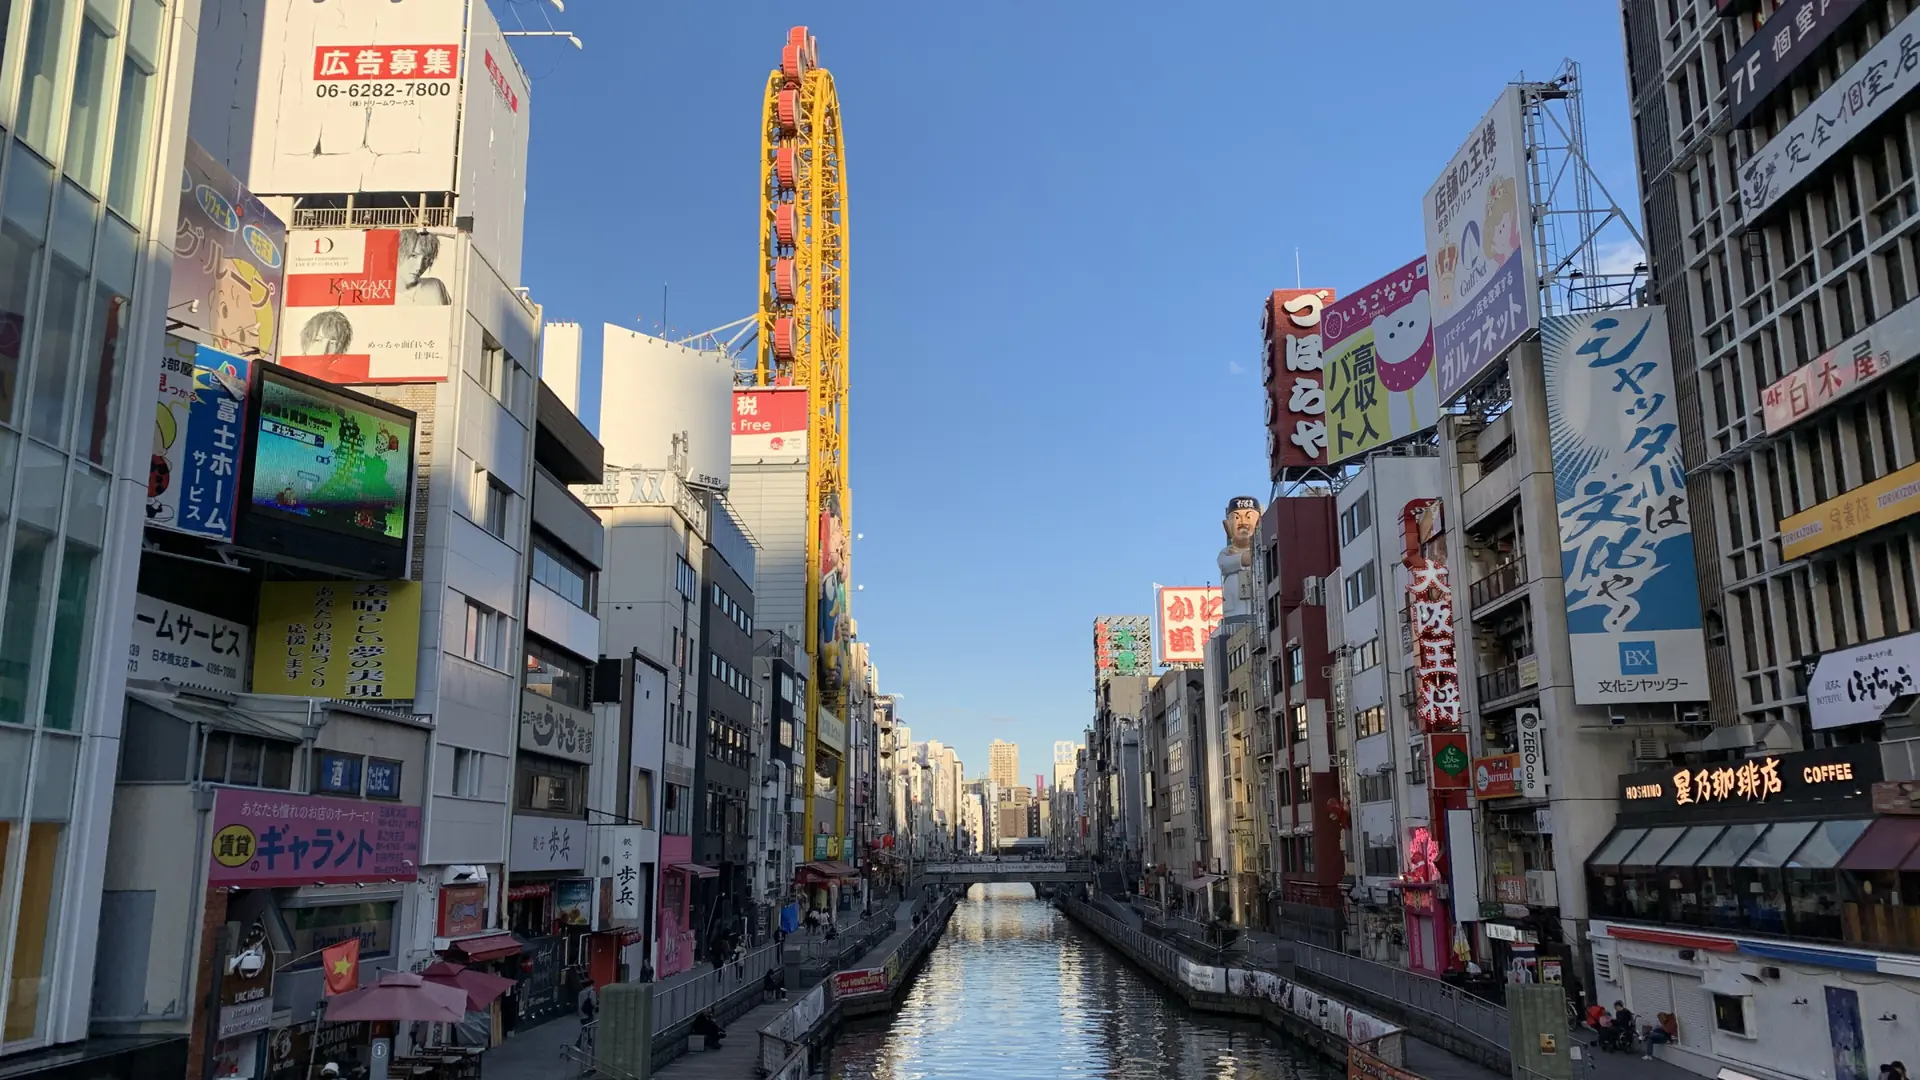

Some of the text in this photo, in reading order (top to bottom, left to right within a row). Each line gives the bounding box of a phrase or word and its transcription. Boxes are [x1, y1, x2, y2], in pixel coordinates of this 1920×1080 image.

[320, 48, 451, 76] 広告募集
[1732, 50, 1761, 105] 7F
[316, 82, 450, 98] 06-6282-7800
[1435, 119, 1496, 221] 店舗の王様
[329, 278, 392, 294] KANZAKI
[352, 288, 391, 304] RUKA
[1343, 273, 1414, 322] いちごなび
[1441, 293, 1522, 391] ガルフネット
[1766, 339, 1878, 418] 4F 白木屋
[736, 395, 758, 416] 税
[740, 419, 772, 431] Free
[1330, 354, 1354, 454] バイト
[187, 449, 208, 521] サービス
[204, 397, 239, 532] 富士ホーム
[311, 586, 334, 688] あなたのお店づくり
[1408, 558, 1461, 724] 大阪王将
[1625, 650, 1653, 666] BX
[532, 703, 578, 754] うなぎ
[1523, 731, 1537, 765] ZERO
[330, 758, 345, 790] 酒
[366, 765, 391, 792] たばこ
[1625, 757, 1853, 806] HOSHINO 星乃珈琲店 COFFEE
[219, 822, 375, 872] 賃貸 の ギャラント
[548, 825, 571, 863] 歩兵
[615, 865, 637, 906] 歩兵
